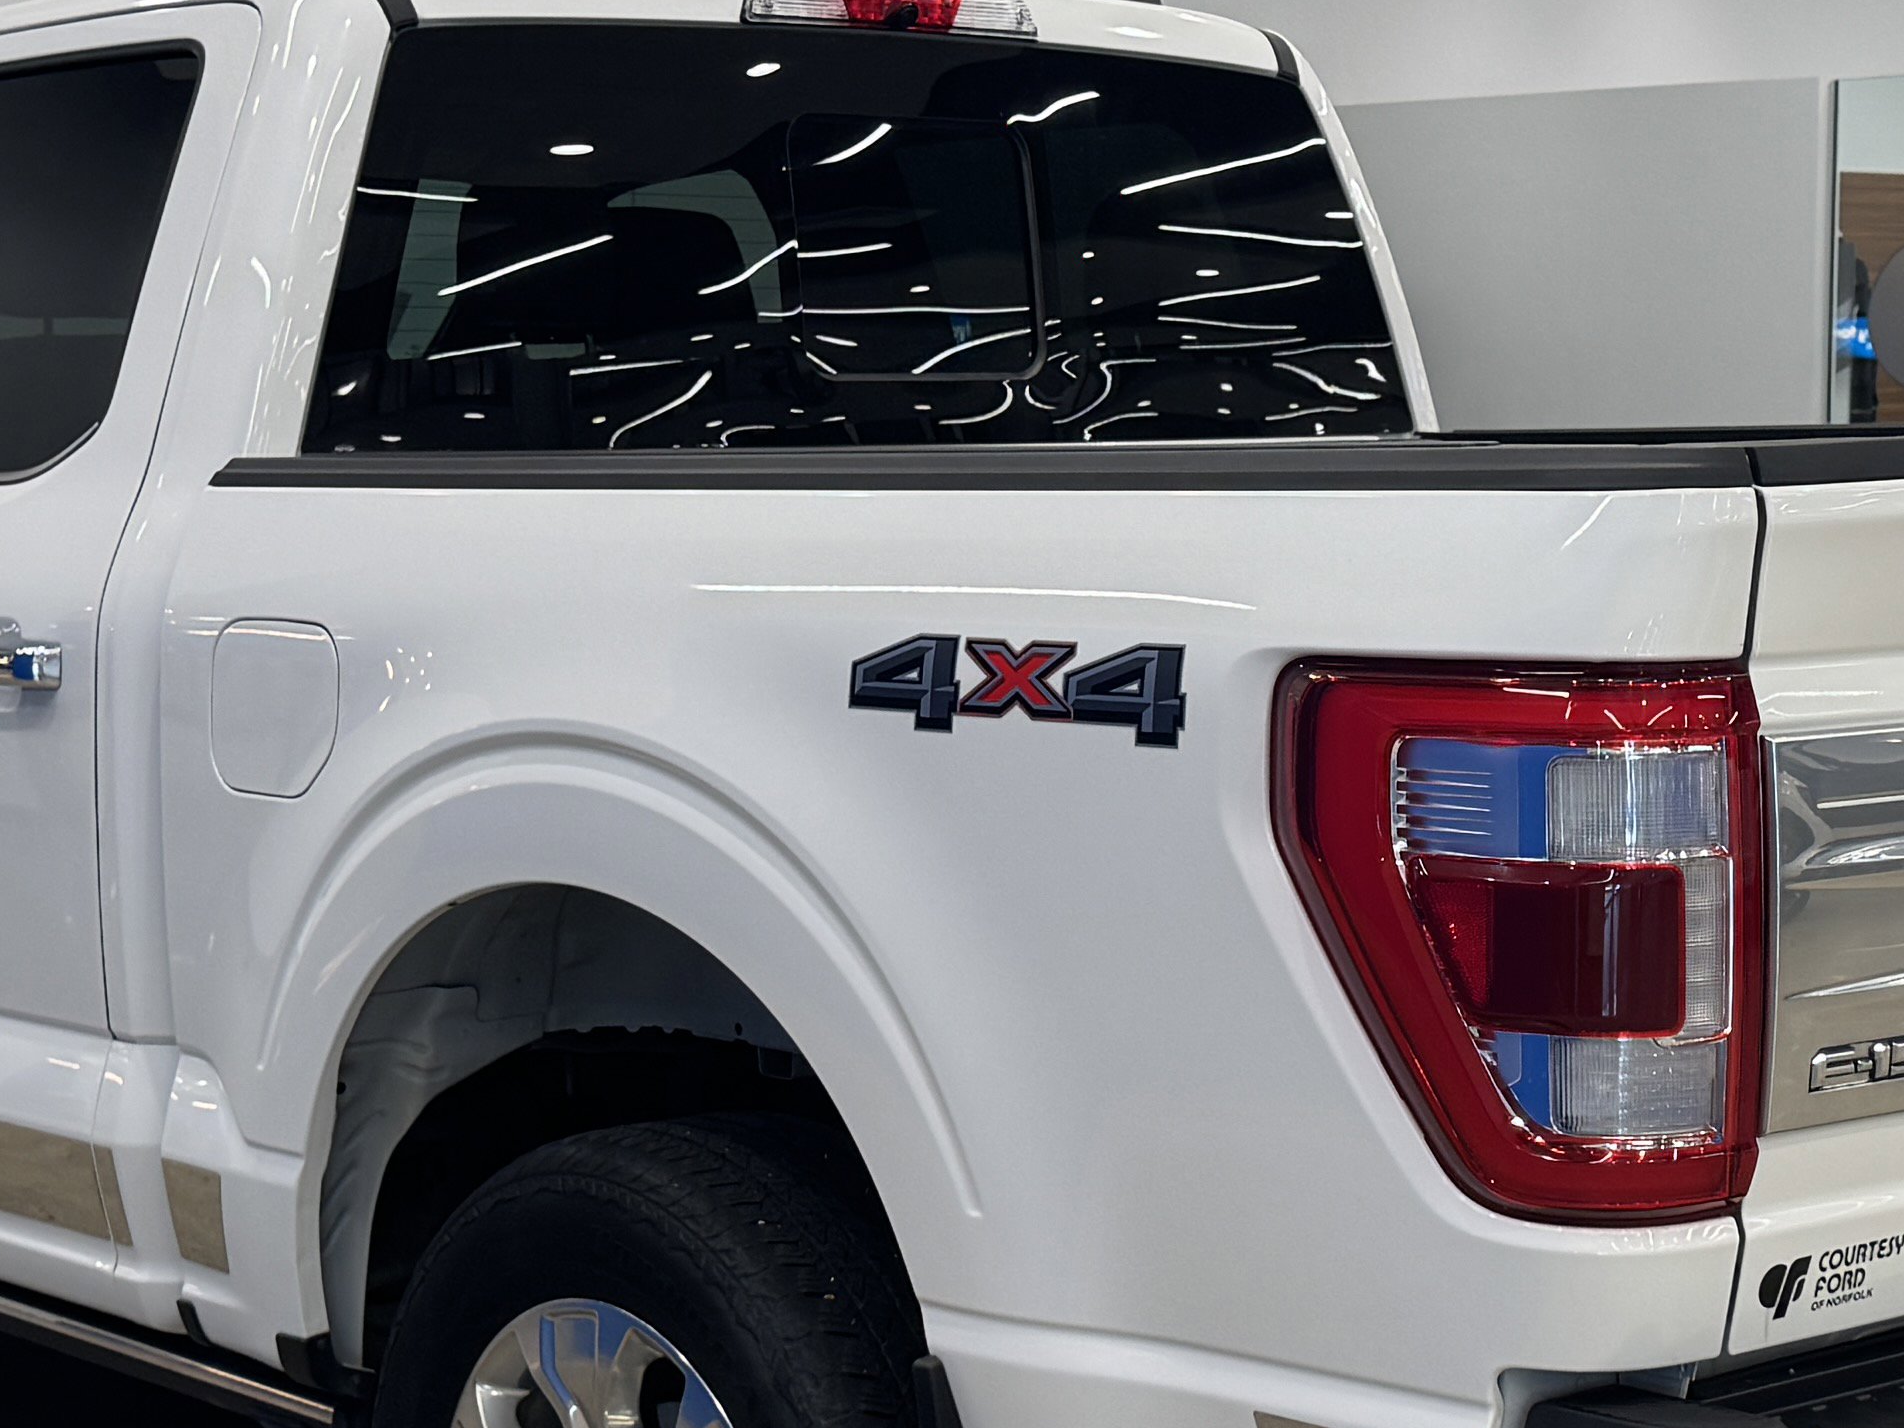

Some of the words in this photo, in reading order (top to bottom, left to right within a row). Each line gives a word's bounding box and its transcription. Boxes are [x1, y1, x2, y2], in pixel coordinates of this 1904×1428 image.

[1813, 1267, 1866, 1297] FORD
[1810, 1298, 1825, 1311] OF
[1826, 1288, 1874, 1308] NORFOLK
